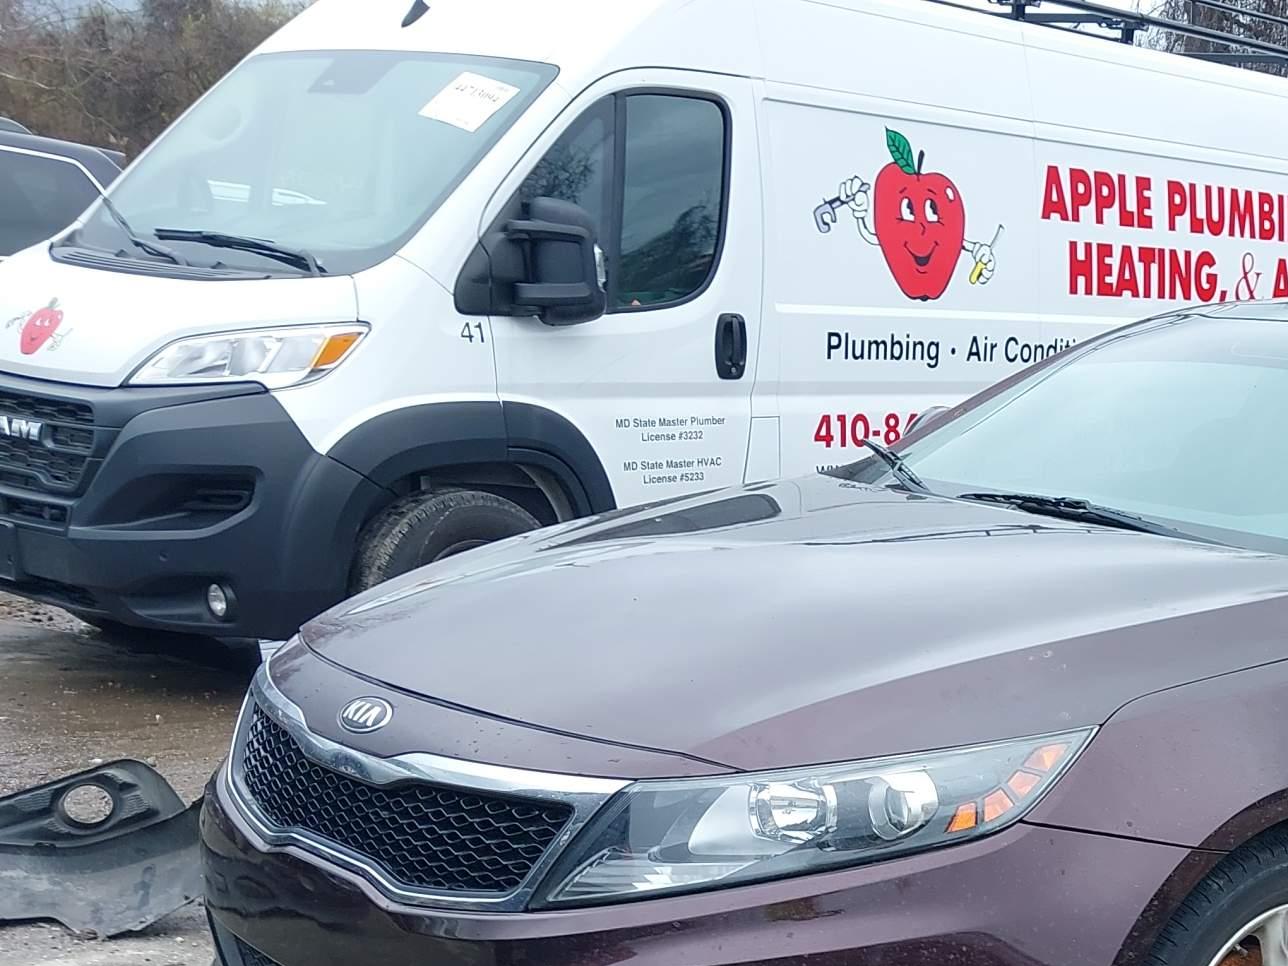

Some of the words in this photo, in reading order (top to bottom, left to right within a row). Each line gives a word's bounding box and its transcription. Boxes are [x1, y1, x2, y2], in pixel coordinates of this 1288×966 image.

[1041, 165, 1153, 229] APPLE
[1069, 241, 1228, 303] HEATING,
[1235, 252, 1264, 301] &
[461, 321, 485, 344] 41
[826, 332, 940, 369] Plumbing
[966, 336, 998, 363] Air
[615, 418, 631, 429] MD
[633, 418, 657, 428] State
[659, 417, 689, 427] Master
[691, 416, 726, 427] Plumber
[641, 432, 677, 442] License
[679, 430, 704, 440] #3232
[624, 461, 638, 471] MD
[641, 460, 664, 470] State
[666, 459, 695, 469] Master
[697, 457, 722, 467] HVAC
[643, 474, 678, 484] License
[680, 472, 705, 482] #5233
